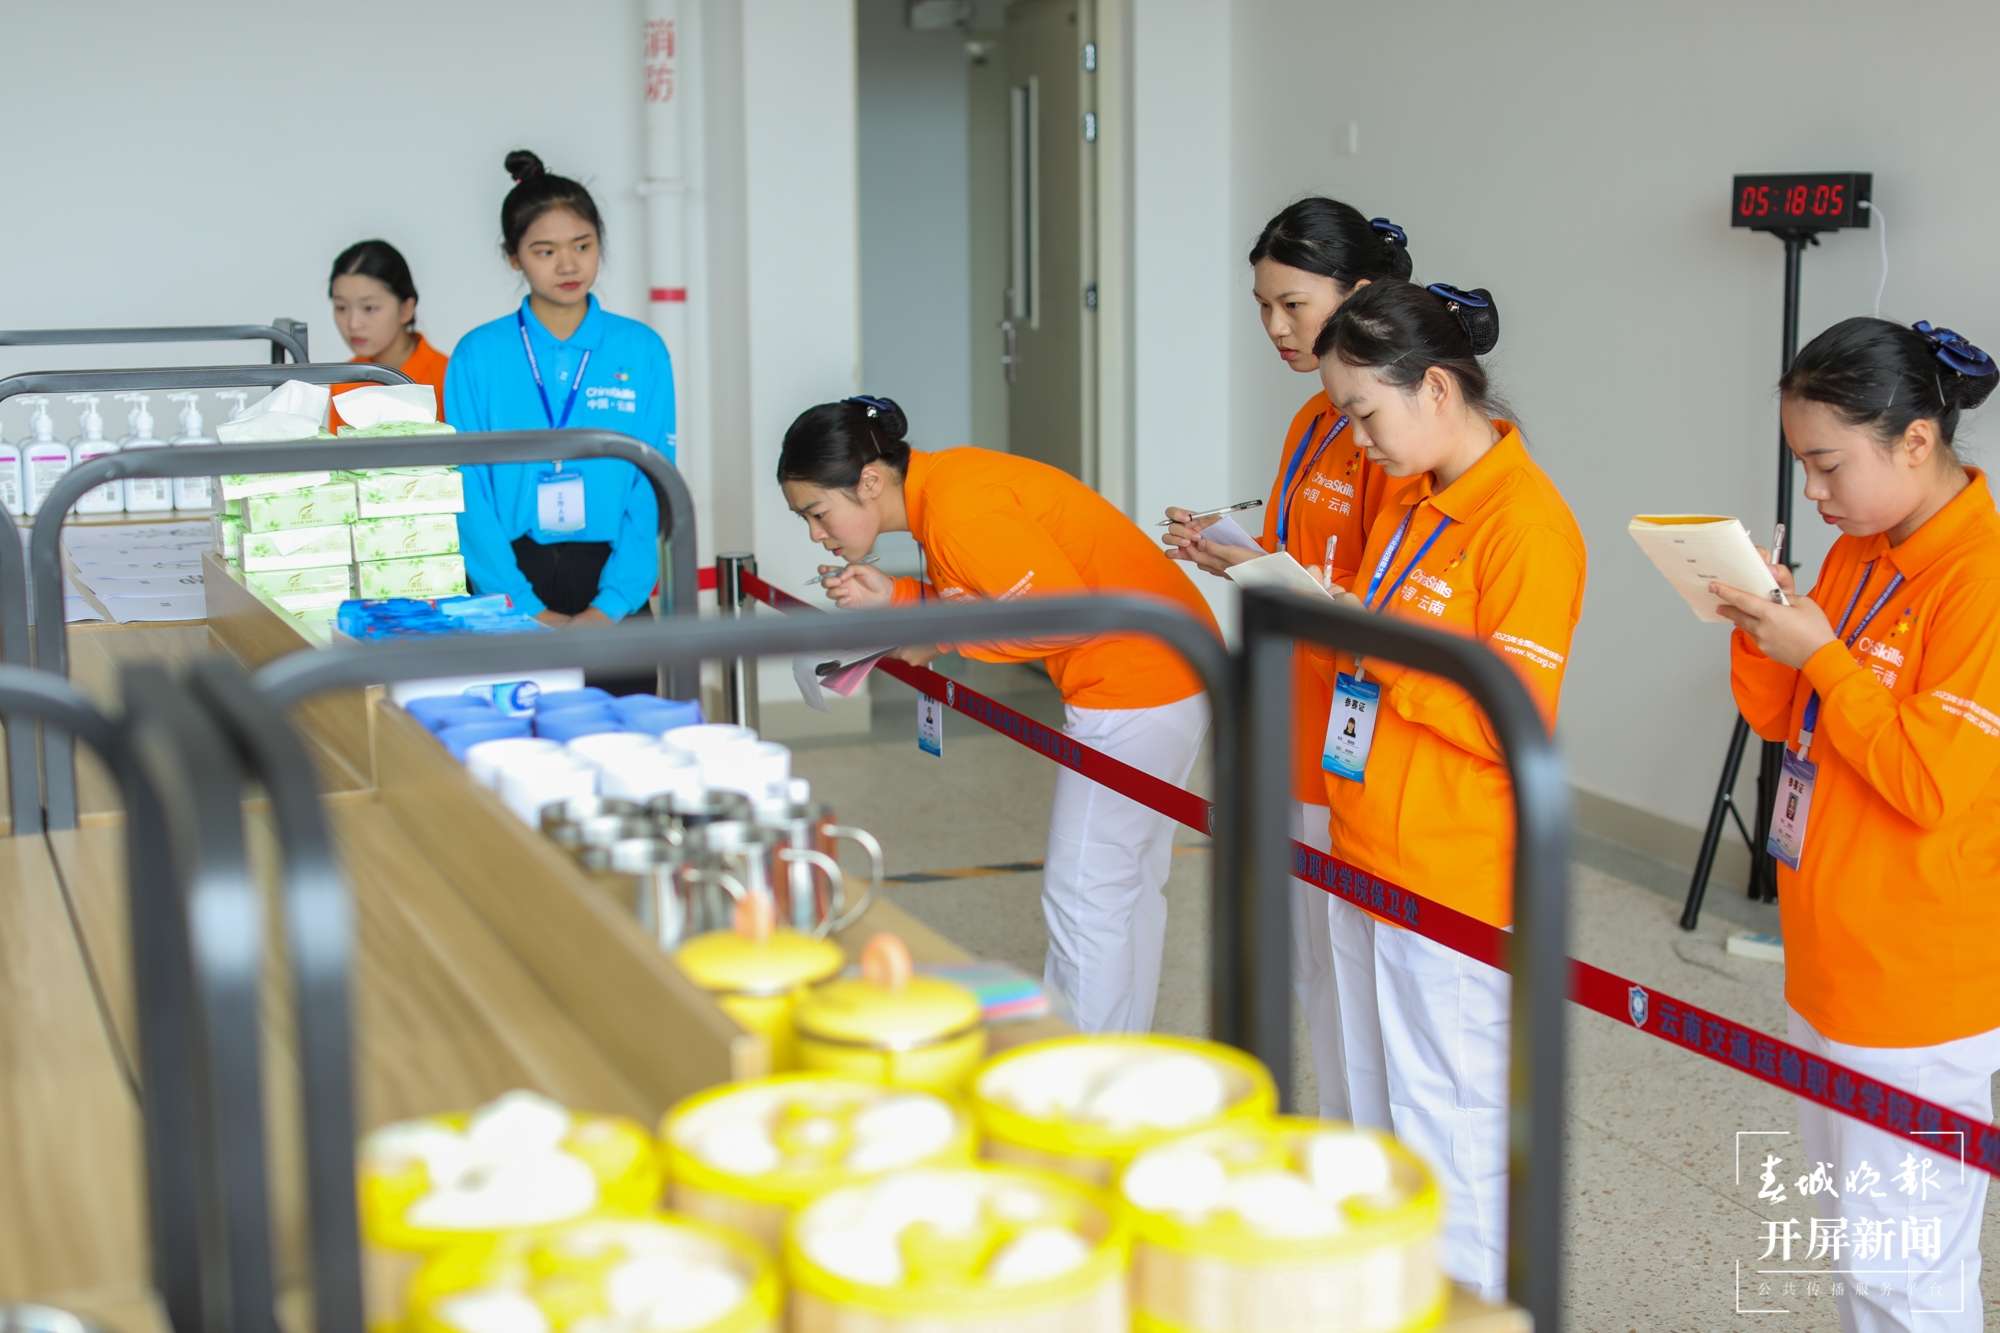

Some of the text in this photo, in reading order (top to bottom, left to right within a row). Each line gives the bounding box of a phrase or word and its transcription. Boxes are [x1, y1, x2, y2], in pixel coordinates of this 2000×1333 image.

[645, 20, 674, 101] 消防
[1740, 185, 1844, 217] 05:18:05
[1344, 696, 1367, 712] 参赛证
